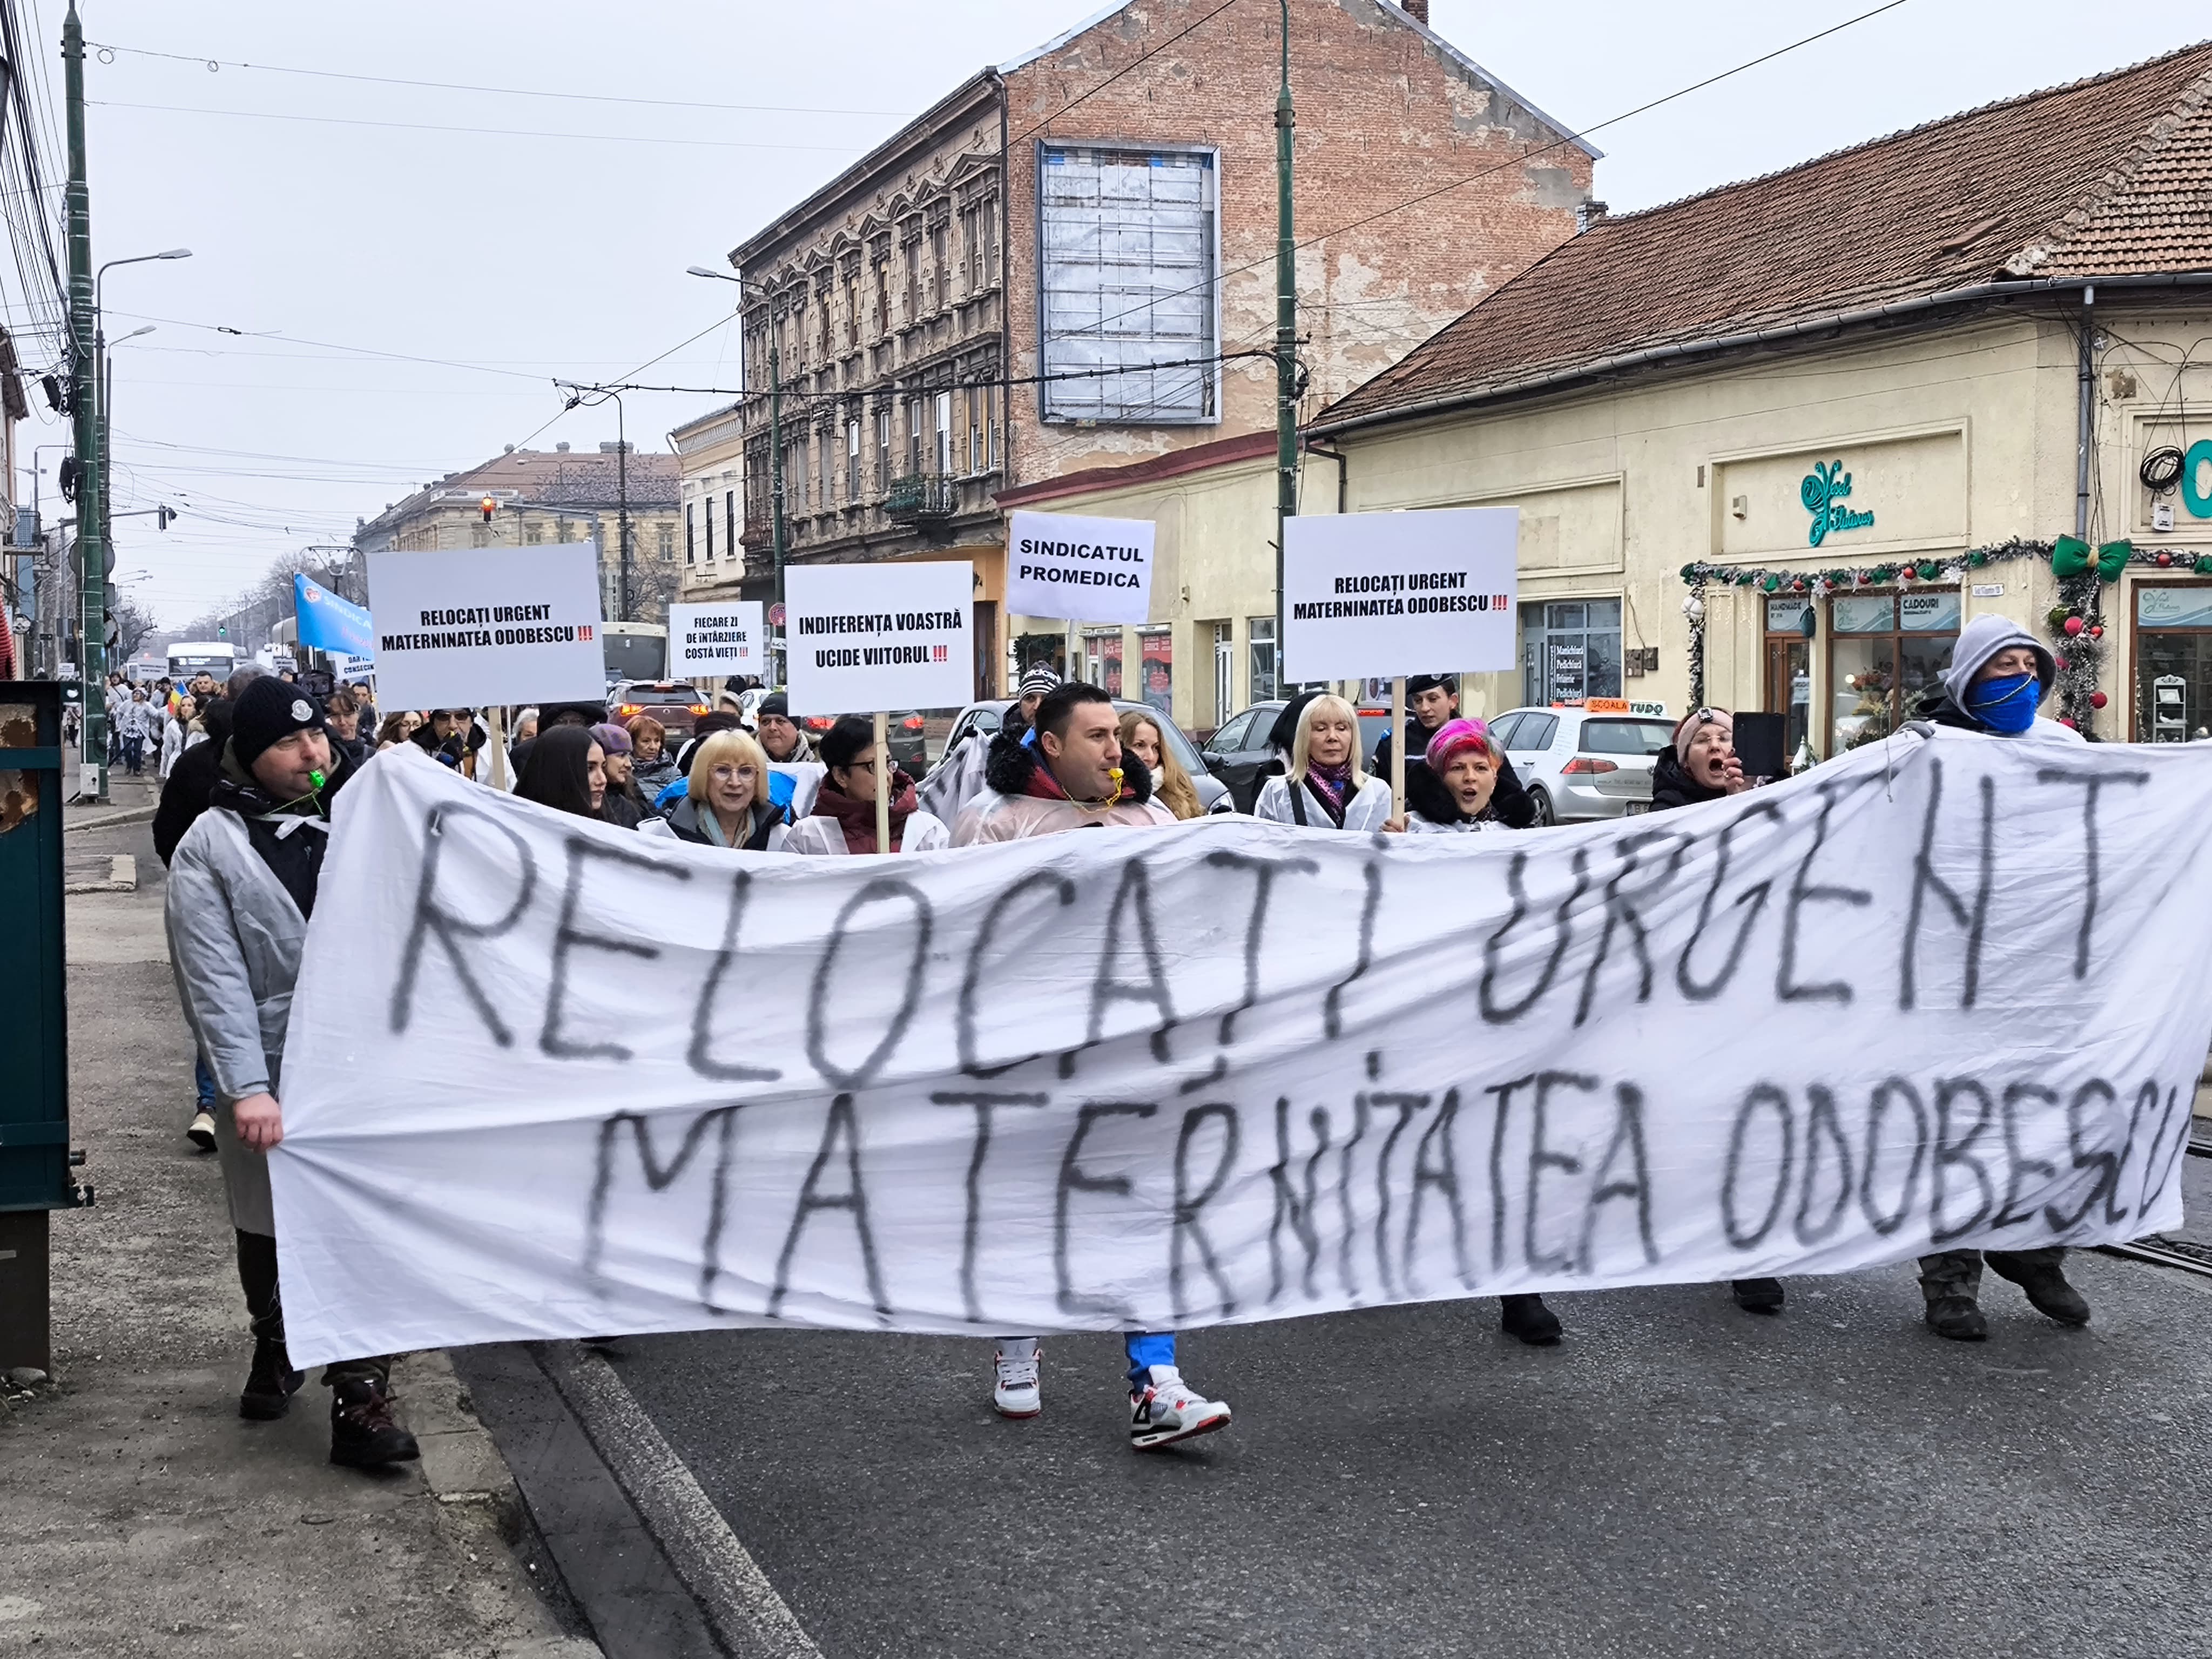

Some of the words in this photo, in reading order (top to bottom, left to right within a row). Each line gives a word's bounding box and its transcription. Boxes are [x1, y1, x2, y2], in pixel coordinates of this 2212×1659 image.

[1020, 539, 1144, 562] SINDICATUL
[1020, 565, 1140, 588] PROMEDICA
[1335, 575, 1404, 596] RELOCAȚI
[1409, 572, 1467, 590] URGENT
[1294, 597, 1404, 620] MATERNINATEA
[1407, 595, 1488, 615] ODOBESCU
[1492, 595, 1507, 611] !!!
[1903, 598, 1939, 609] CADOURI
[421, 607, 490, 627] RELOCAȚI
[494, 604, 551, 623] URGENT
[694, 617, 729, 628] FIECARE
[731, 616, 738, 626] ZI
[799, 614, 893, 637] INDIFERENȚA
[896, 608, 962, 631] VOASTRĂ
[382, 630, 492, 651] MATERNINATEA
[495, 626, 574, 645] ODOBESCU
[577, 625, 593, 642] !!!
[686, 633, 697, 643] DE
[699, 631, 746, 643] ÎNTÂRZIERE
[685, 646, 714, 659] COSTĂ
[716, 647, 737, 660] VIEȚI
[739, 647, 748, 657] !!!
[816, 649, 860, 667] UCIDE
[864, 646, 929, 665] VIITORUL
[933, 645, 947, 662] !!!
[1478, 758, 2149, 1028] URGENT
[582, 1052, 1659, 1322] MATERNITATEA
[1721, 1074, 2200, 1250] ODOBESCU
